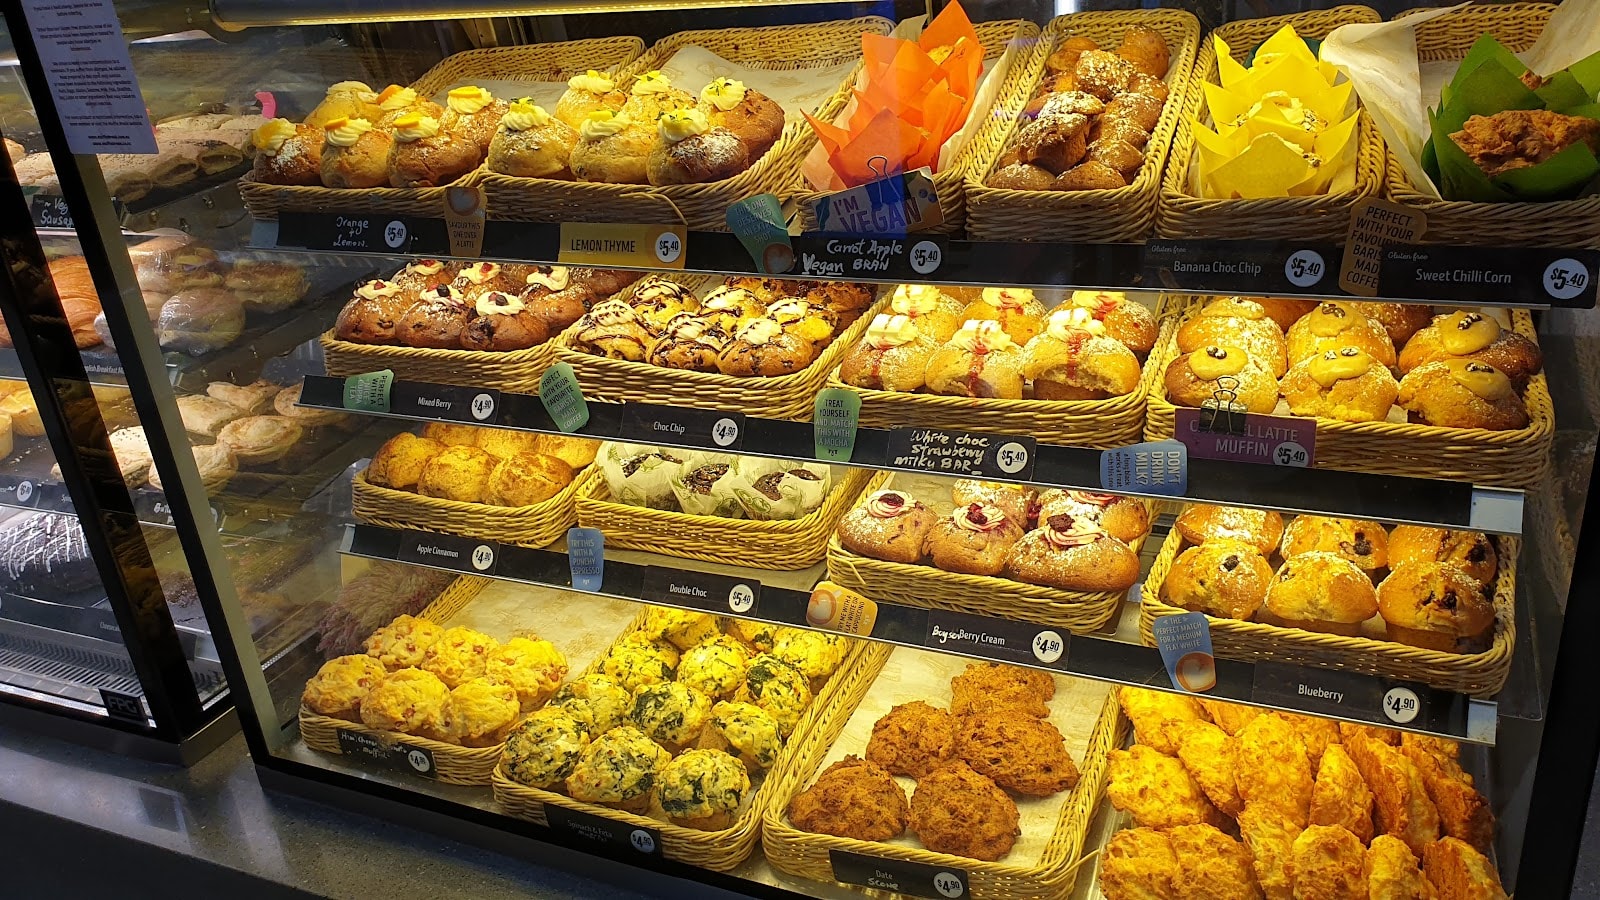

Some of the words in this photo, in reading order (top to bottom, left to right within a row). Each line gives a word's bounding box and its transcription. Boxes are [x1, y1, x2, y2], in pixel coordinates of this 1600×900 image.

[736, 203, 750, 215] THIS
[751, 198, 768, 210] ONE
[833, 196, 859, 216] I'M
[737, 208, 772, 226] DESERVES
[839, 197, 922, 233] VEGAN
[1366, 206, 1413, 226] PERFECT
[336, 216, 368, 235] Orange
[468, 222, 480, 230] THIS
[1356, 217, 1385, 233] WITH
[1386, 225, 1414, 240] YOUR
[755, 231, 771, 242] SHOT
[571, 240, 602, 251] LEMON
[605, 240, 636, 253] THYME
[659, 240, 679, 257] $5.40
[826, 239, 866, 255] Carrot
[867, 240, 903, 261] Apple
[802, 253, 844, 275] Vegan
[852, 258, 889, 271] BRAN
[914, 248, 938, 267] $5.40
[1387, 250, 1412, 260] Gluten
[1412, 252, 1429, 262] free
[1174, 262, 1210, 273] Banana
[1213, 263, 1237, 274] Choc
[1238, 264, 1262, 278] Chip
[1291, 257, 1321, 279] $5.40
[1354, 261, 1379, 274] MAD
[1416, 268, 1450, 282] Sweet
[1452, 270, 1482, 284] Chilli
[1484, 272, 1512, 284] Corn
[1346, 271, 1379, 289] COFFE
[1550, 267, 1586, 291] $5.40
[370, 378, 380, 398] WITH
[542, 371, 561, 389] PERFECT
[543, 386, 555, 399] WITH
[554, 376, 570, 390] YOUR
[349, 385, 357, 400] TEA
[355, 379, 364, 404] CUPPA
[363, 381, 371, 401] NICE
[377, 375, 388, 407] PERFECT
[547, 384, 574, 407] FAVOURITE
[418, 396, 435, 407] Mixed
[435, 399, 452, 411] Berry
[554, 395, 577, 413] BARISTA
[825, 399, 843, 408] TREAT
[563, 412, 582, 429] COFFEE
[819, 409, 850, 418] YOURSELF
[653, 421, 669, 432] Choc
[670, 423, 685, 436] Chip
[816, 428, 830, 436] THIS
[831, 429, 850, 437] WITH
[830, 420, 853, 428] MATCH
[910, 430, 950, 445] White
[955, 434, 991, 448] choc
[1258, 427, 1298, 440] LATTE
[824, 439, 848, 447] MOCHA
[1215, 439, 1269, 457] MUFFIN
[1002, 450, 1025, 467] $5.40
[1115, 452, 1123, 468] works
[1277, 447, 1305, 465] $5.40
[1135, 452, 1149, 486] MILK?
[1151, 451, 1165, 486] DRINK
[1167, 451, 1181, 485] DON'T
[417, 544, 432, 555] Apple
[432, 546, 459, 558] Cinnamon
[582, 539, 594, 547] THIS
[572, 566, 601, 575] ESPRESSO
[670, 584, 691, 595] Double
[692, 587, 707, 597] Choc
[732, 591, 751, 606] $5.40
[842, 599, 850, 613] WITH
[847, 604, 857, 621] WHITE
[1156, 625, 1181, 635] PERFECT
[1181, 622, 1202, 631] MATCH
[1178, 631, 1203, 641] MEDIUM
[980, 633, 1006, 646] Cream
[1036, 637, 1060, 655] $4.90
[1180, 640, 1201, 650] WHITE
[1298, 684, 1344, 704] Blueberry
[107, 695, 138, 713] FPG
[1386, 695, 1416, 714] $4.90
[876, 870, 894, 880] Date
[868, 877, 900, 891] Scone
[937, 879, 961, 893] $4.90
